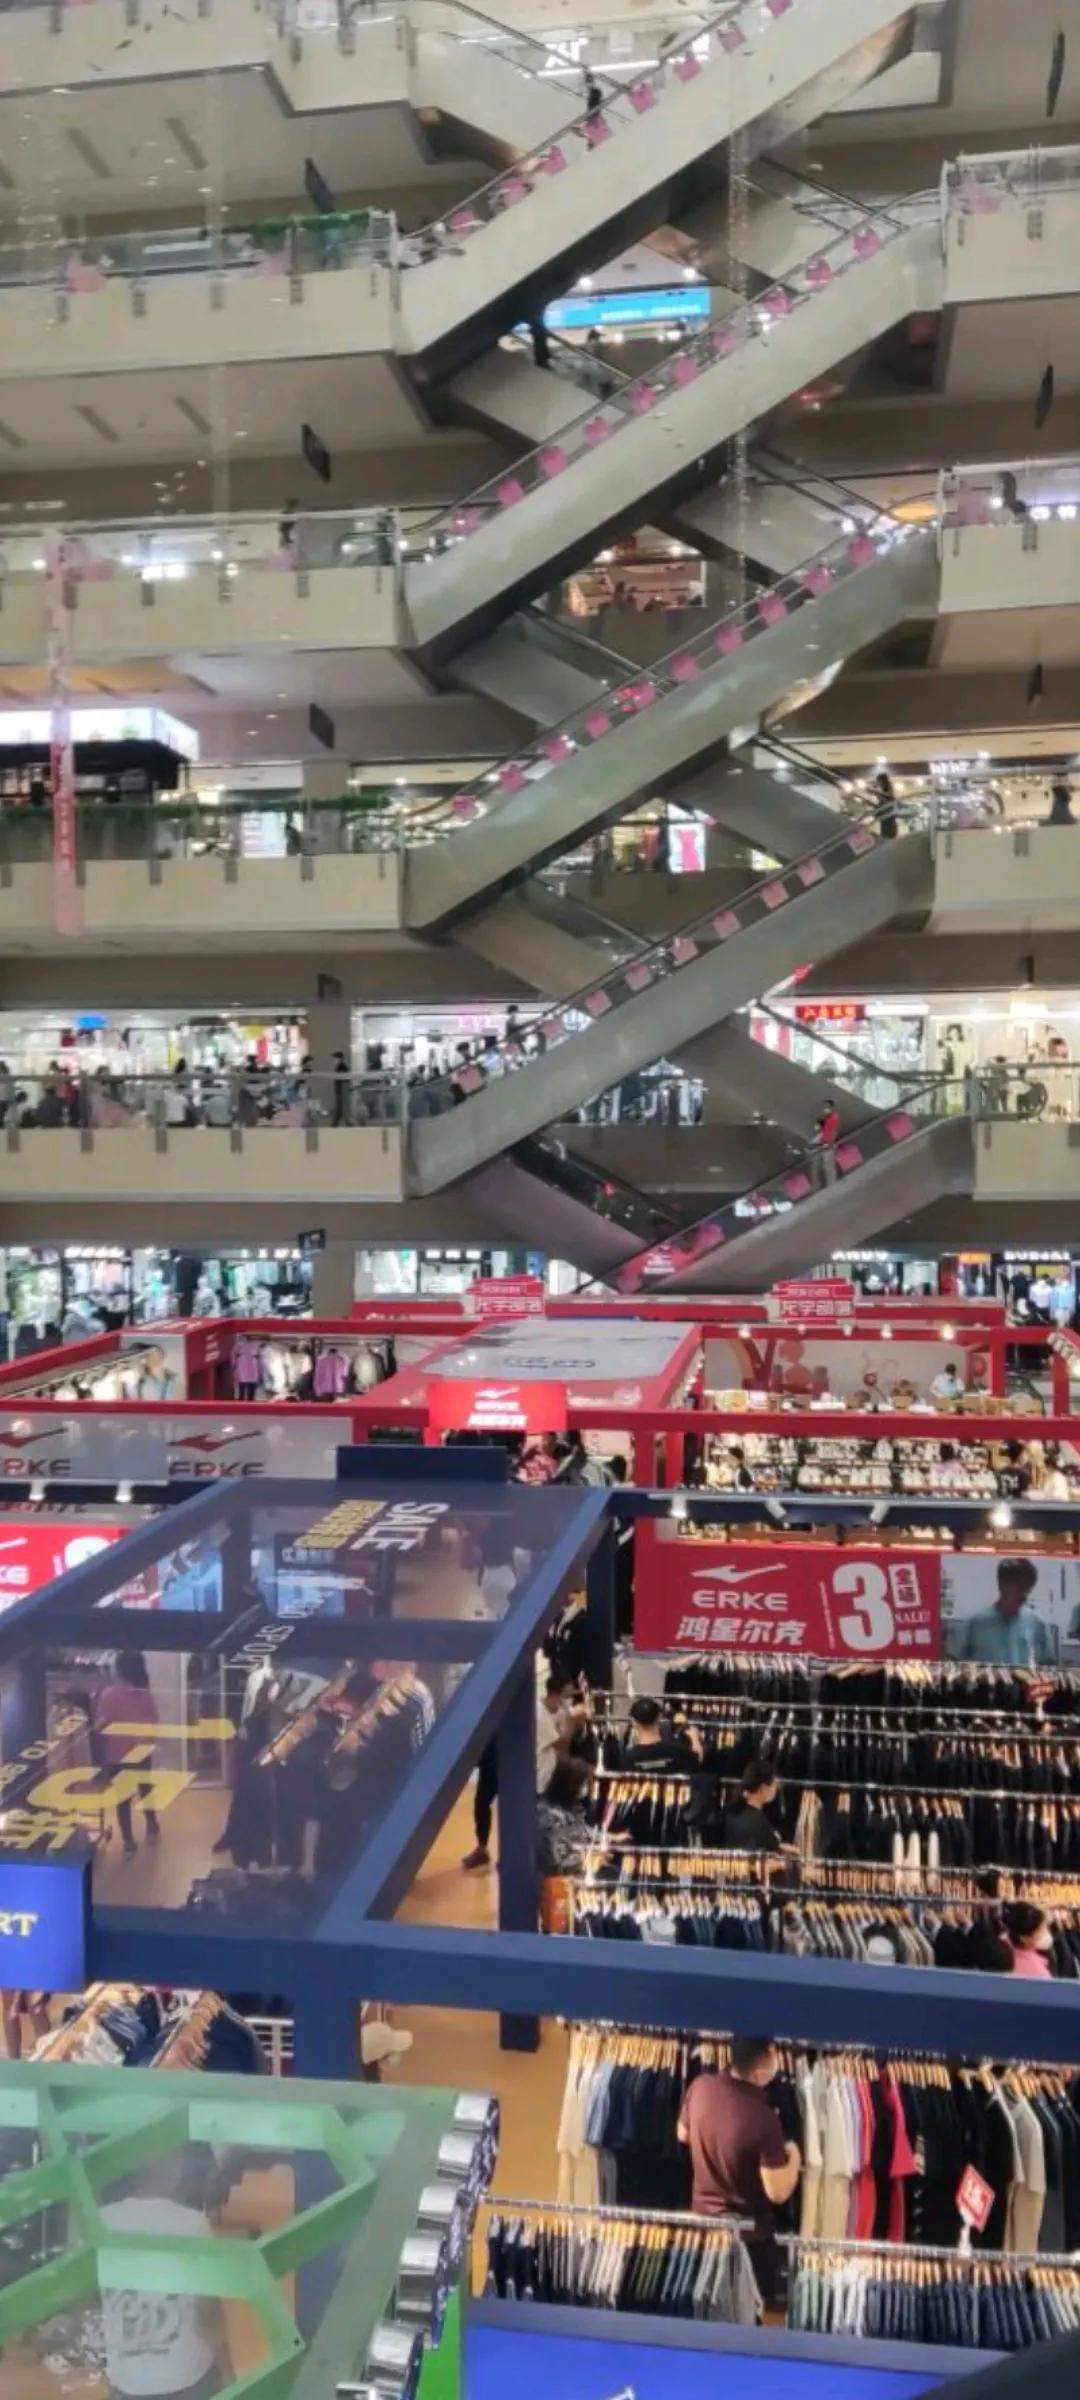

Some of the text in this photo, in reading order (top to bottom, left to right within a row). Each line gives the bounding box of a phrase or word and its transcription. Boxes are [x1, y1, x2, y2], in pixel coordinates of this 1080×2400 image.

[0, 1457, 72, 1477] RKE
[351, 1501, 450, 1551] SALE
[692, 1589, 789, 1611] ERKE
[831, 1561, 895, 1652] 3
[675, 1615, 807, 1646] 鸿星尔克
